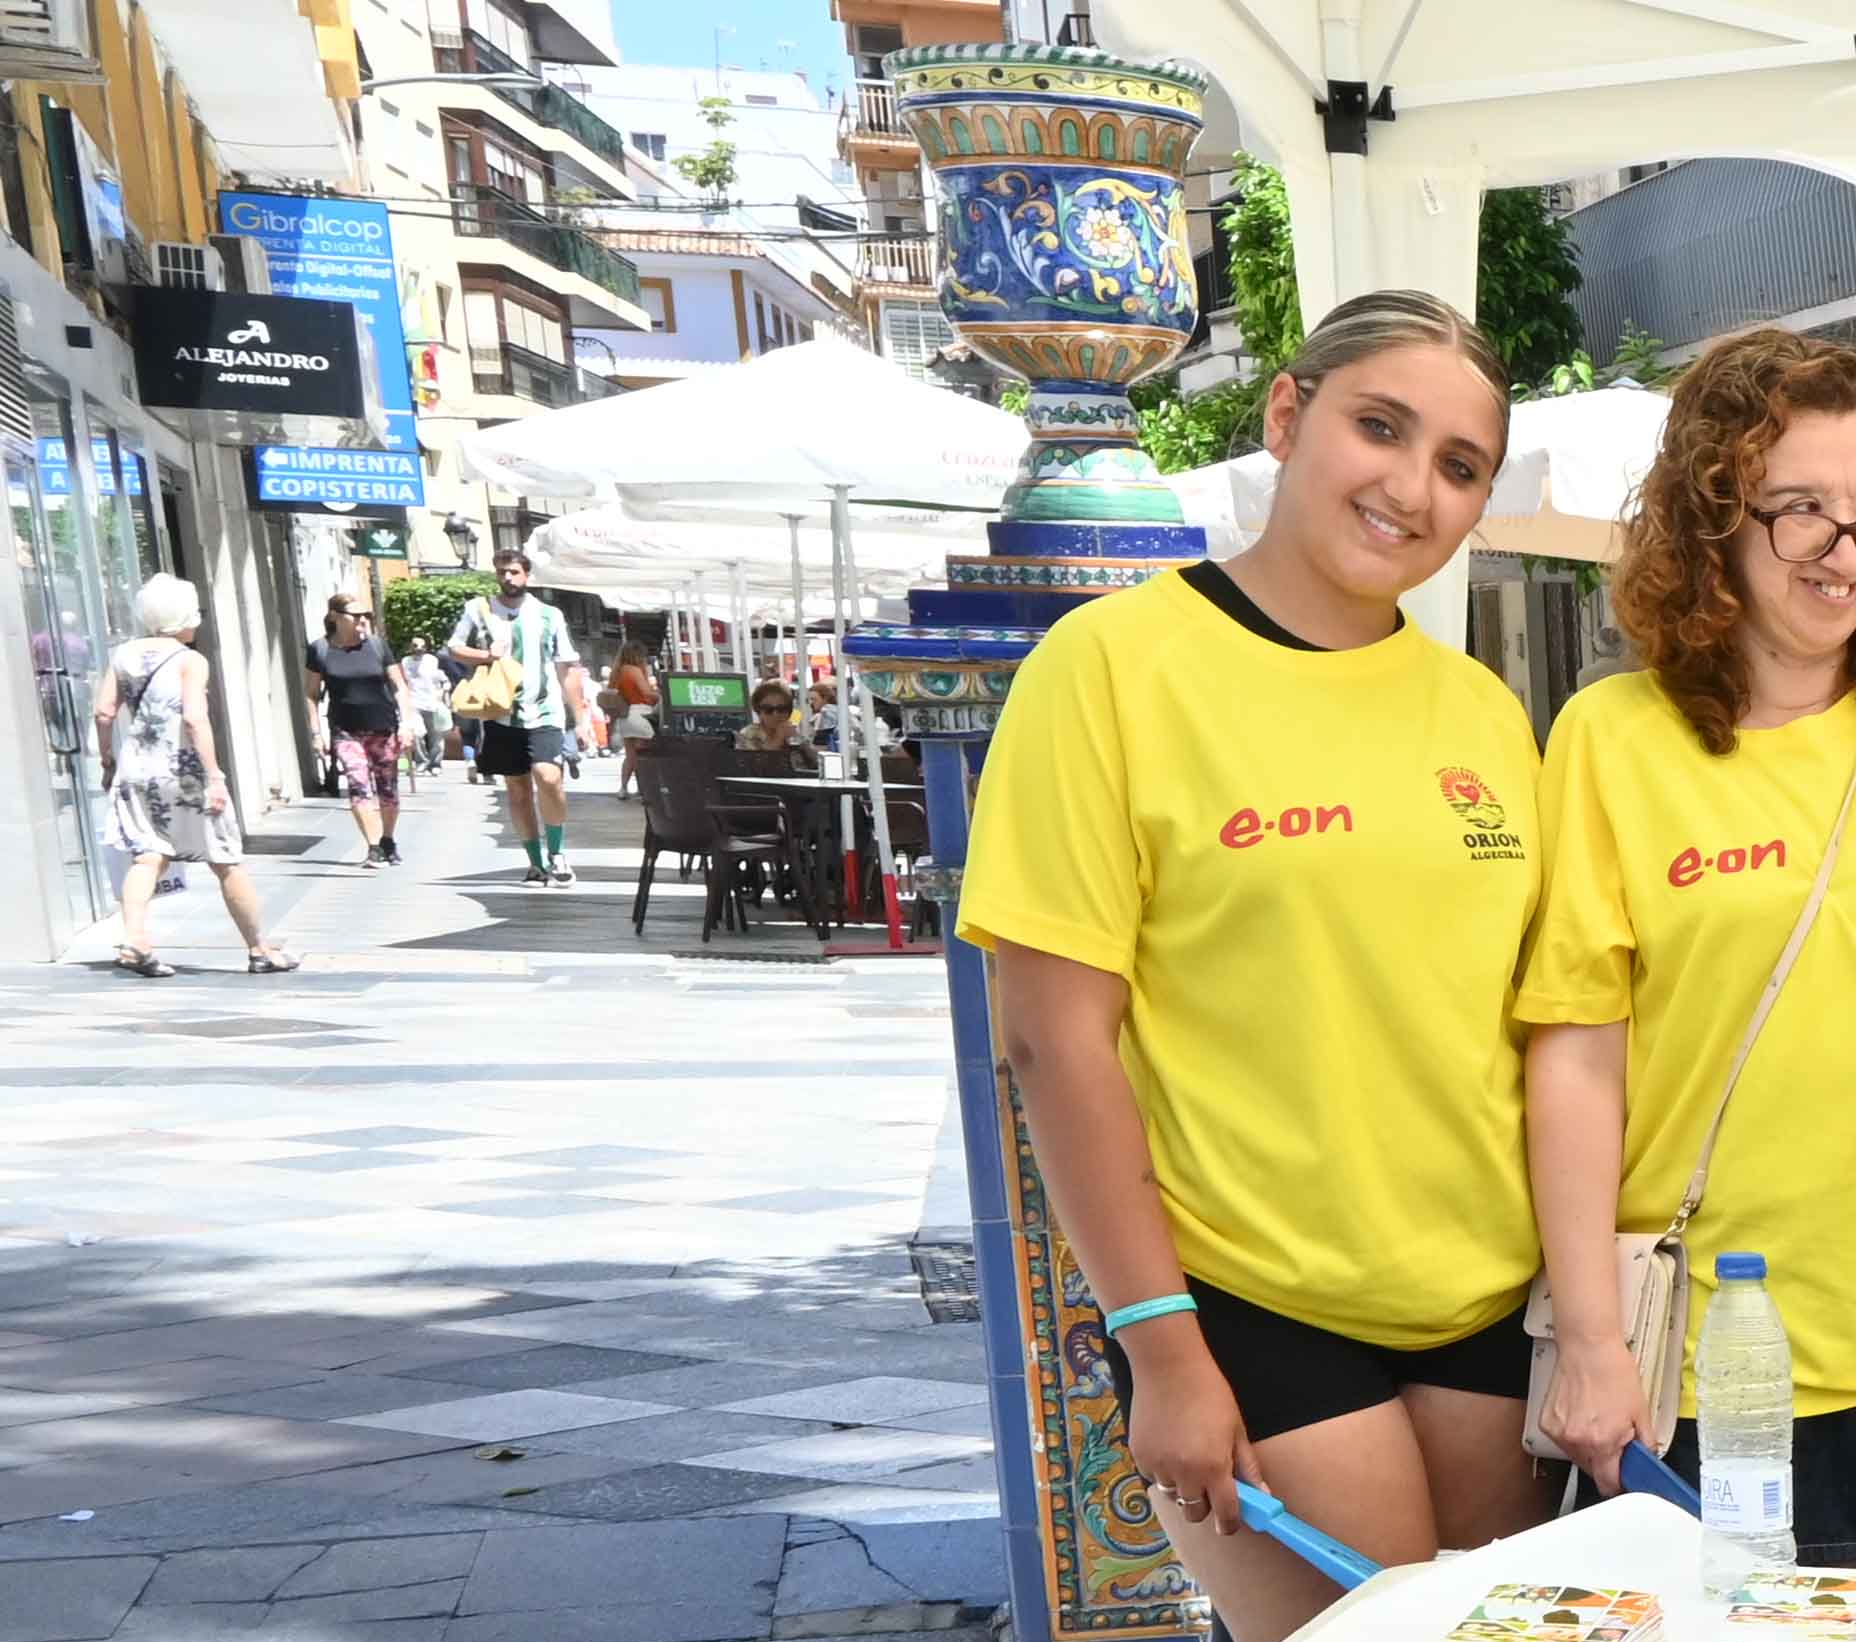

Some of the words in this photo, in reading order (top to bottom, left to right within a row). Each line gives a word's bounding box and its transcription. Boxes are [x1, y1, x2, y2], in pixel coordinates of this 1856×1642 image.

[230, 202, 383, 241] Gibralcop
[320, 240, 385, 256] DIGITAL
[176, 346, 329, 371] ALEJANDRO
[290, 452, 415, 475] IMPRENTA
[264, 478, 416, 501] COPISTERIA
[1463, 832, 1522, 849] ORION
[1470, 849, 1526, 861] ALGECIRAS
